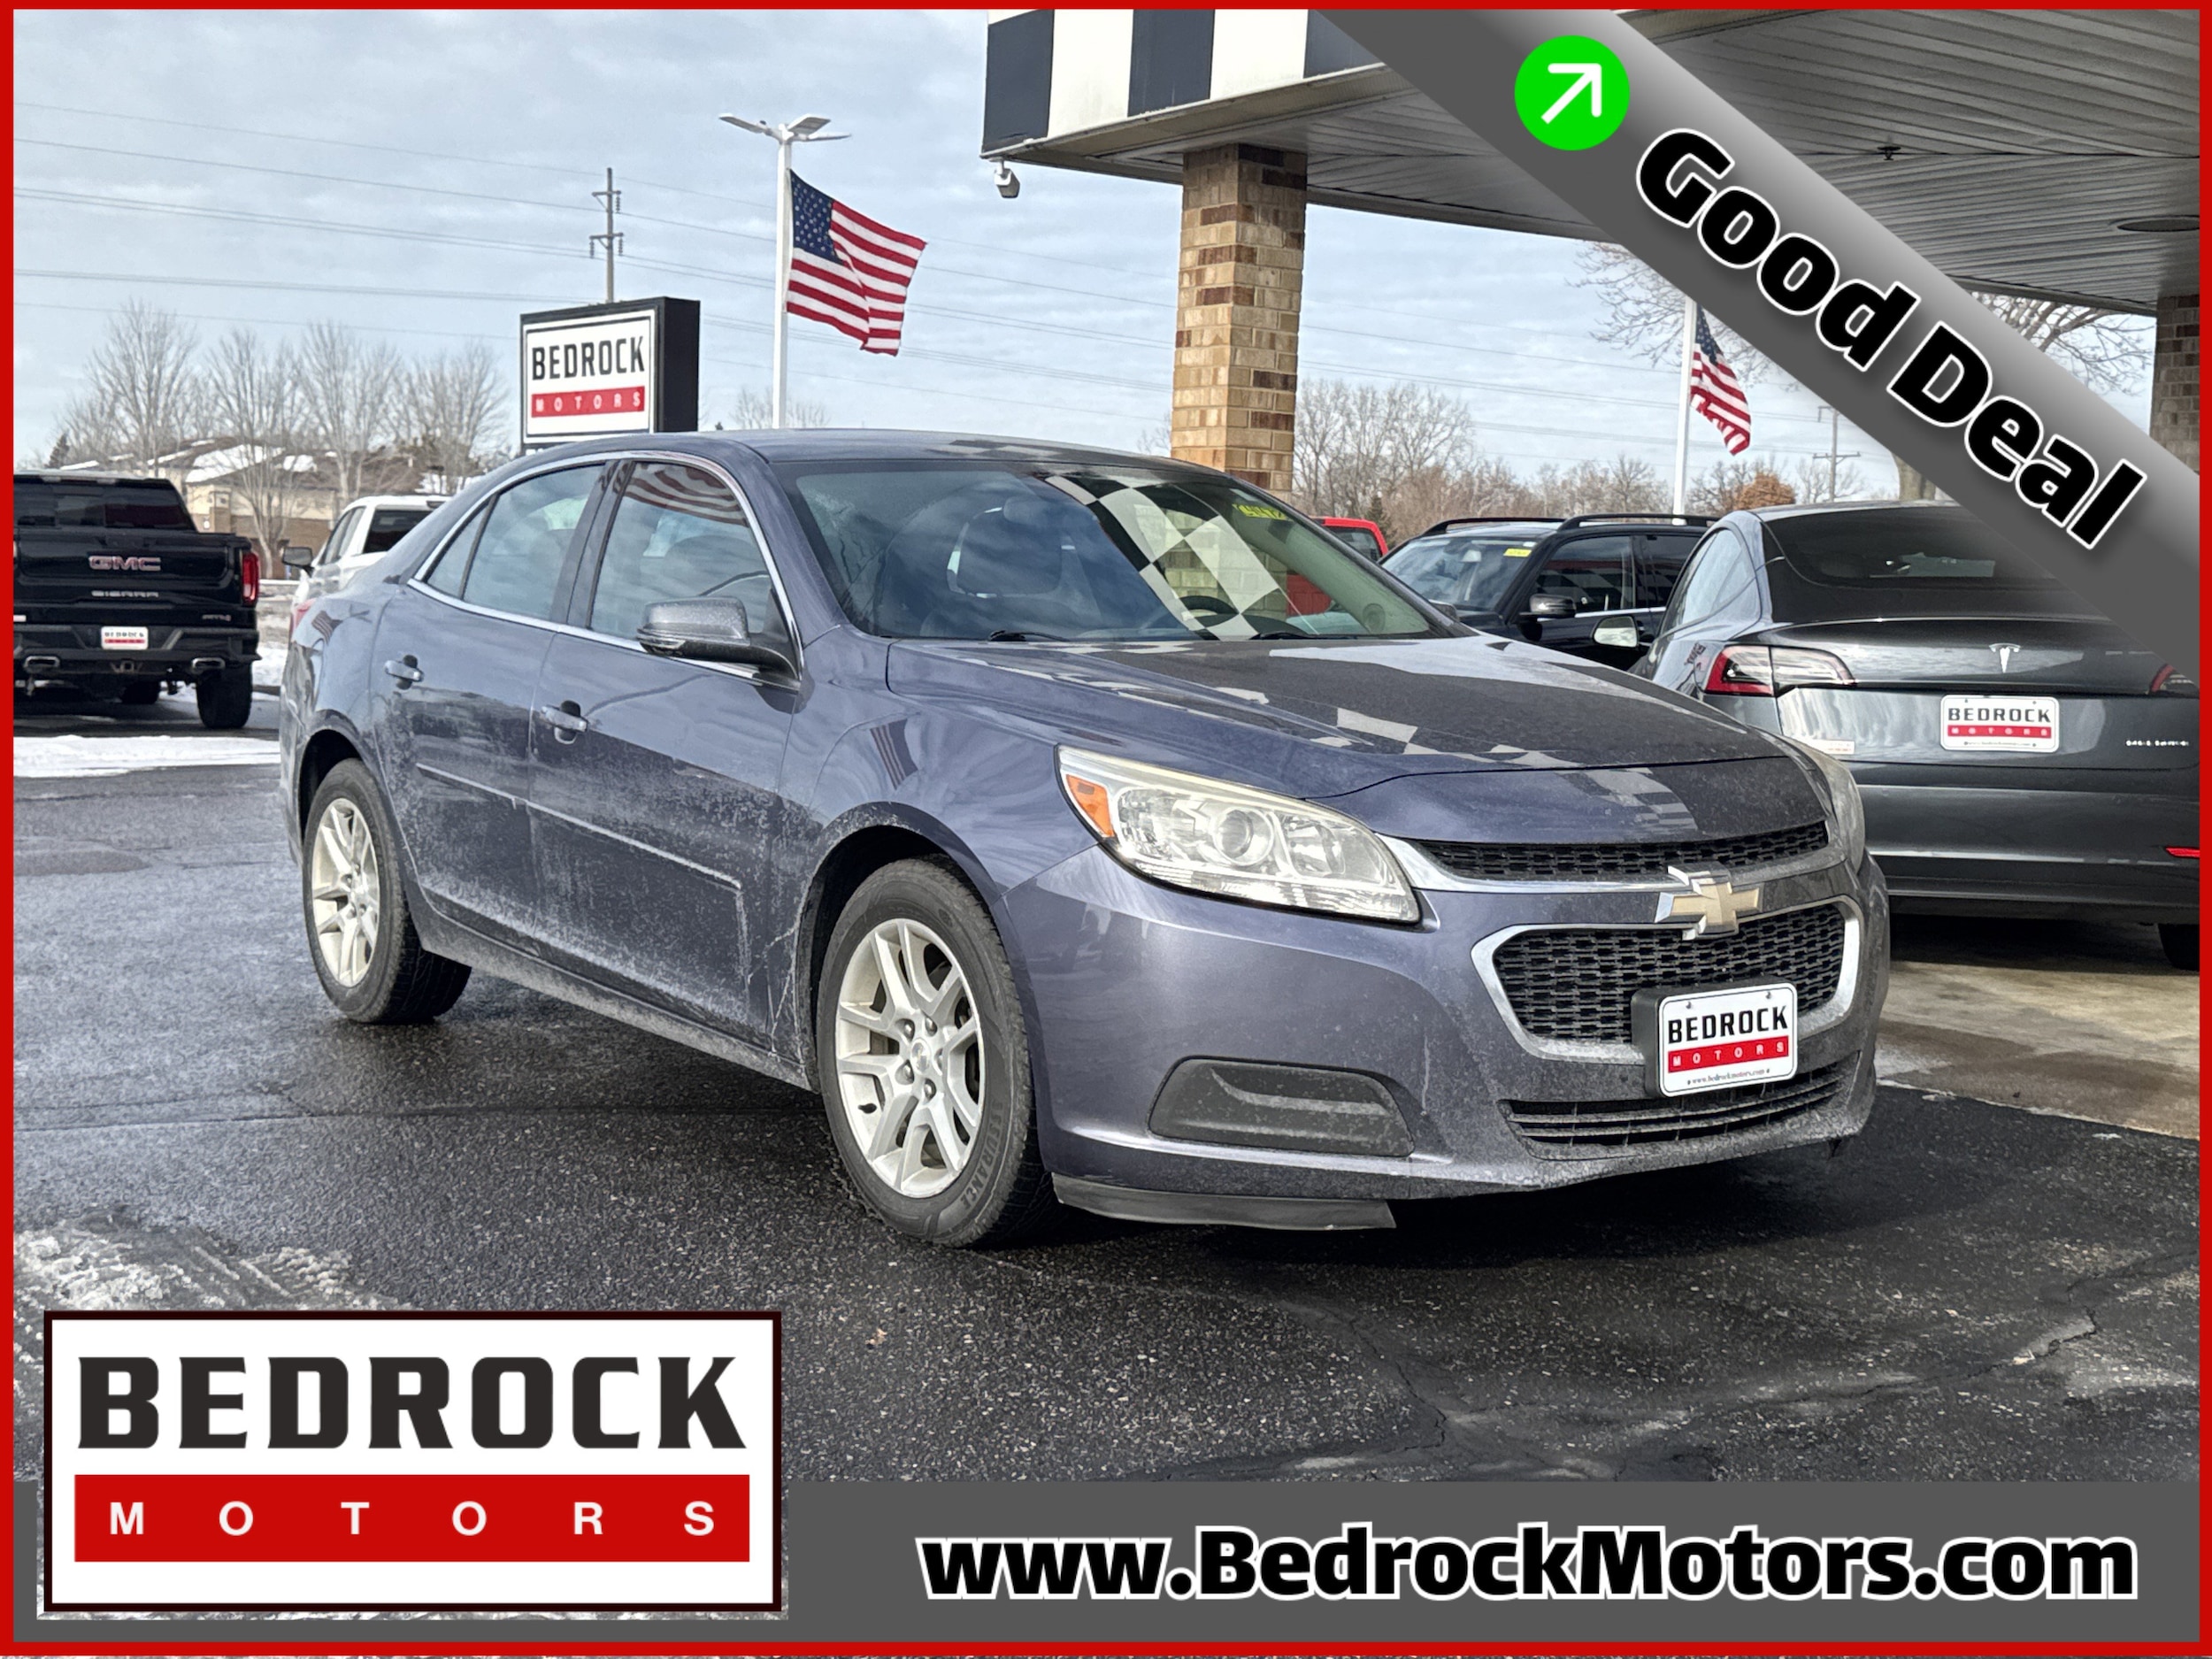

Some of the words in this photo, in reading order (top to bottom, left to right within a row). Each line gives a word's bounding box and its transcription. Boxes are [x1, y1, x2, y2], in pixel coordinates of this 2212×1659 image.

[532, 336, 645, 380] BEDROCK
[535, 392, 641, 412] MOTORS
[88, 556, 161, 571] GMC
[1948, 708, 2051, 723] BEDROCK
[1668, 1005, 1788, 1044] BEDROCK
[1672, 1041, 1785, 1066] MOTORS
